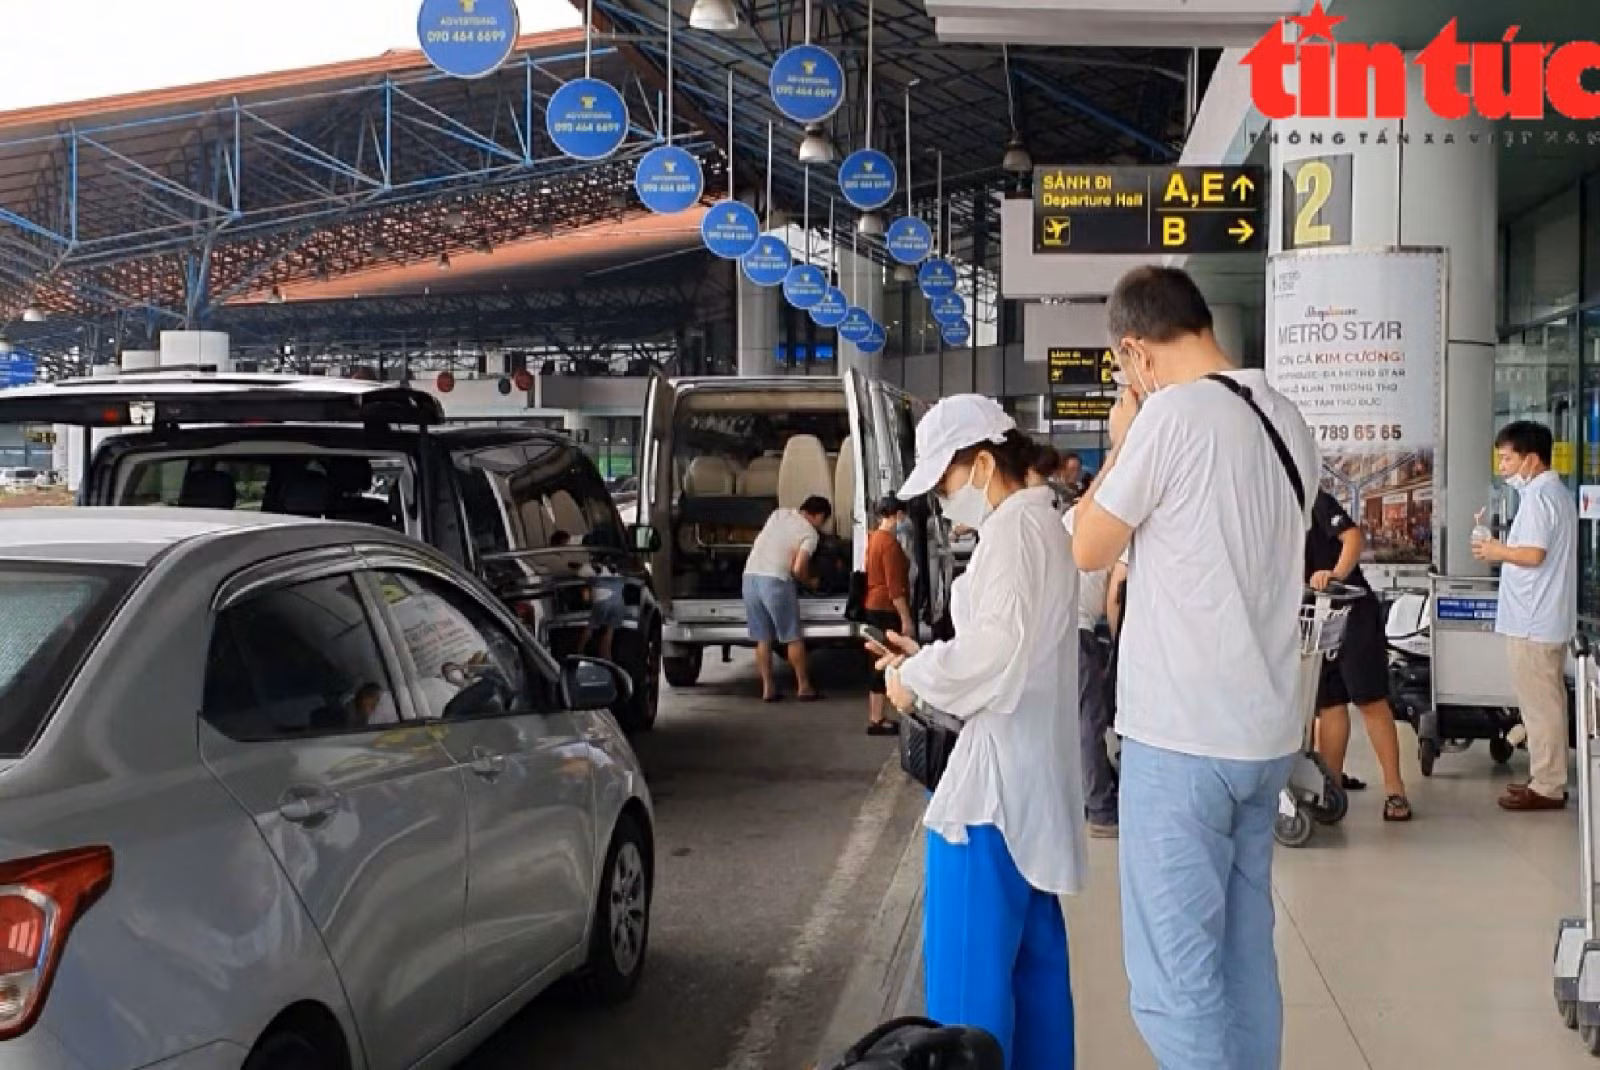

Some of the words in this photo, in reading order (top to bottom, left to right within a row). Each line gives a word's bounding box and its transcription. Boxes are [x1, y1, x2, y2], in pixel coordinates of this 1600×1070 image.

[440, 16, 497, 26] ADVERTISING
[427, 31, 449, 42] 090
[452, 31, 474, 42] 464
[476, 31, 506, 42] 6699
[1043, 194, 1112, 208] Departure
[1116, 194, 1143, 207] Hall
[1294, 160, 1333, 246] 2
[1162, 217, 1187, 246] B
[1278, 321, 1338, 345] METRO
[1343, 321, 1402, 341] STAR
[1315, 353, 1340, 364] KIM
[1319, 424, 1349, 441] 789
[1354, 424, 1375, 441] 65
[1381, 424, 1402, 440] 65
